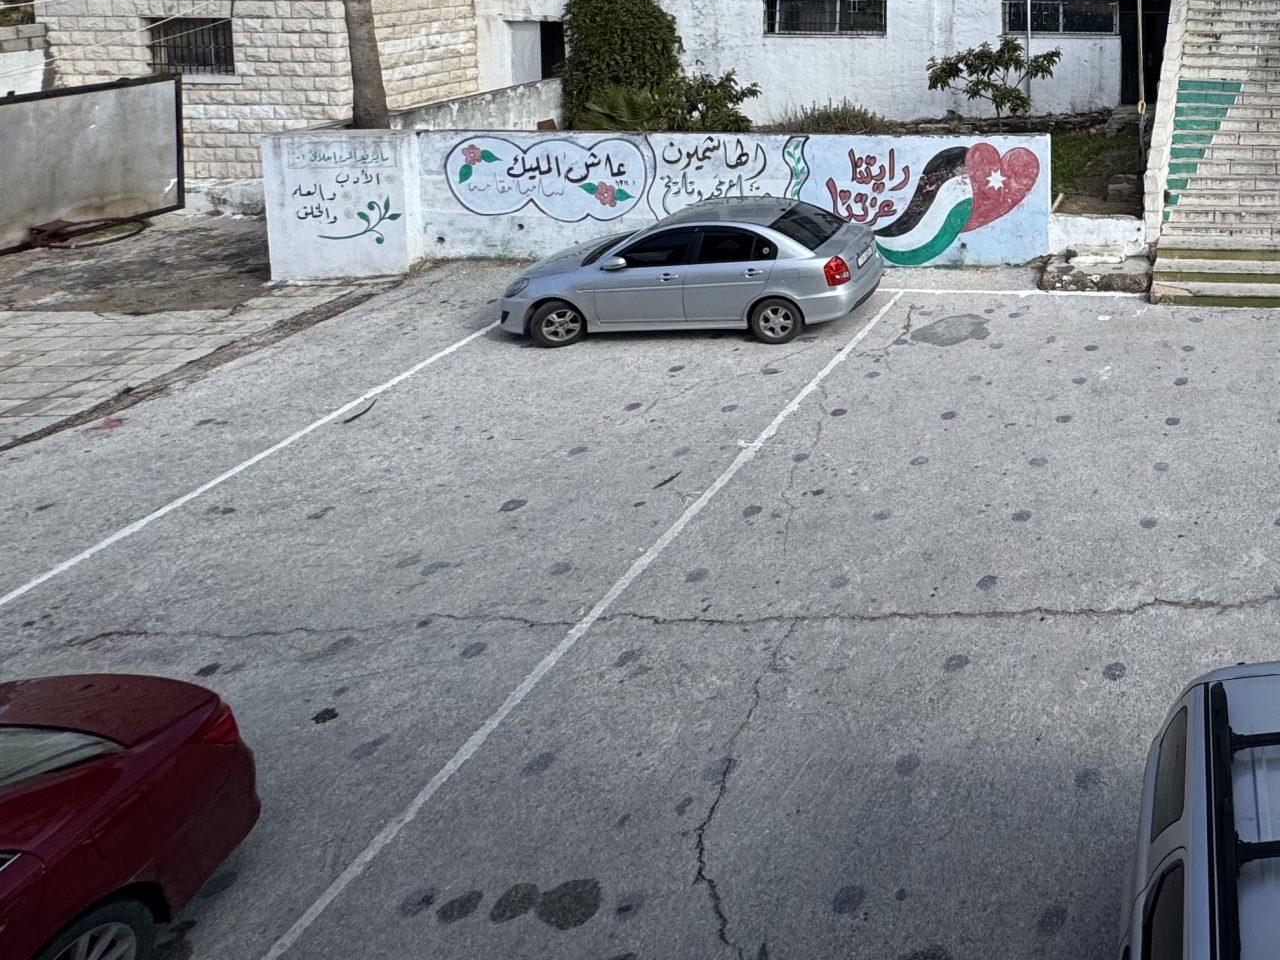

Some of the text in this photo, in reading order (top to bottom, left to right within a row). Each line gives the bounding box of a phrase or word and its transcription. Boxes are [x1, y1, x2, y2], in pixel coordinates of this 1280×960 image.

[335, 170, 380, 187] الأدب
[506, 152, 627, 183] عاش المليك
[848, 148, 911, 194] رايتنا
[292, 183, 337, 201] والعلم
[826, 177, 897, 226] عزتنا
[296, 202, 338, 224] والخلق
